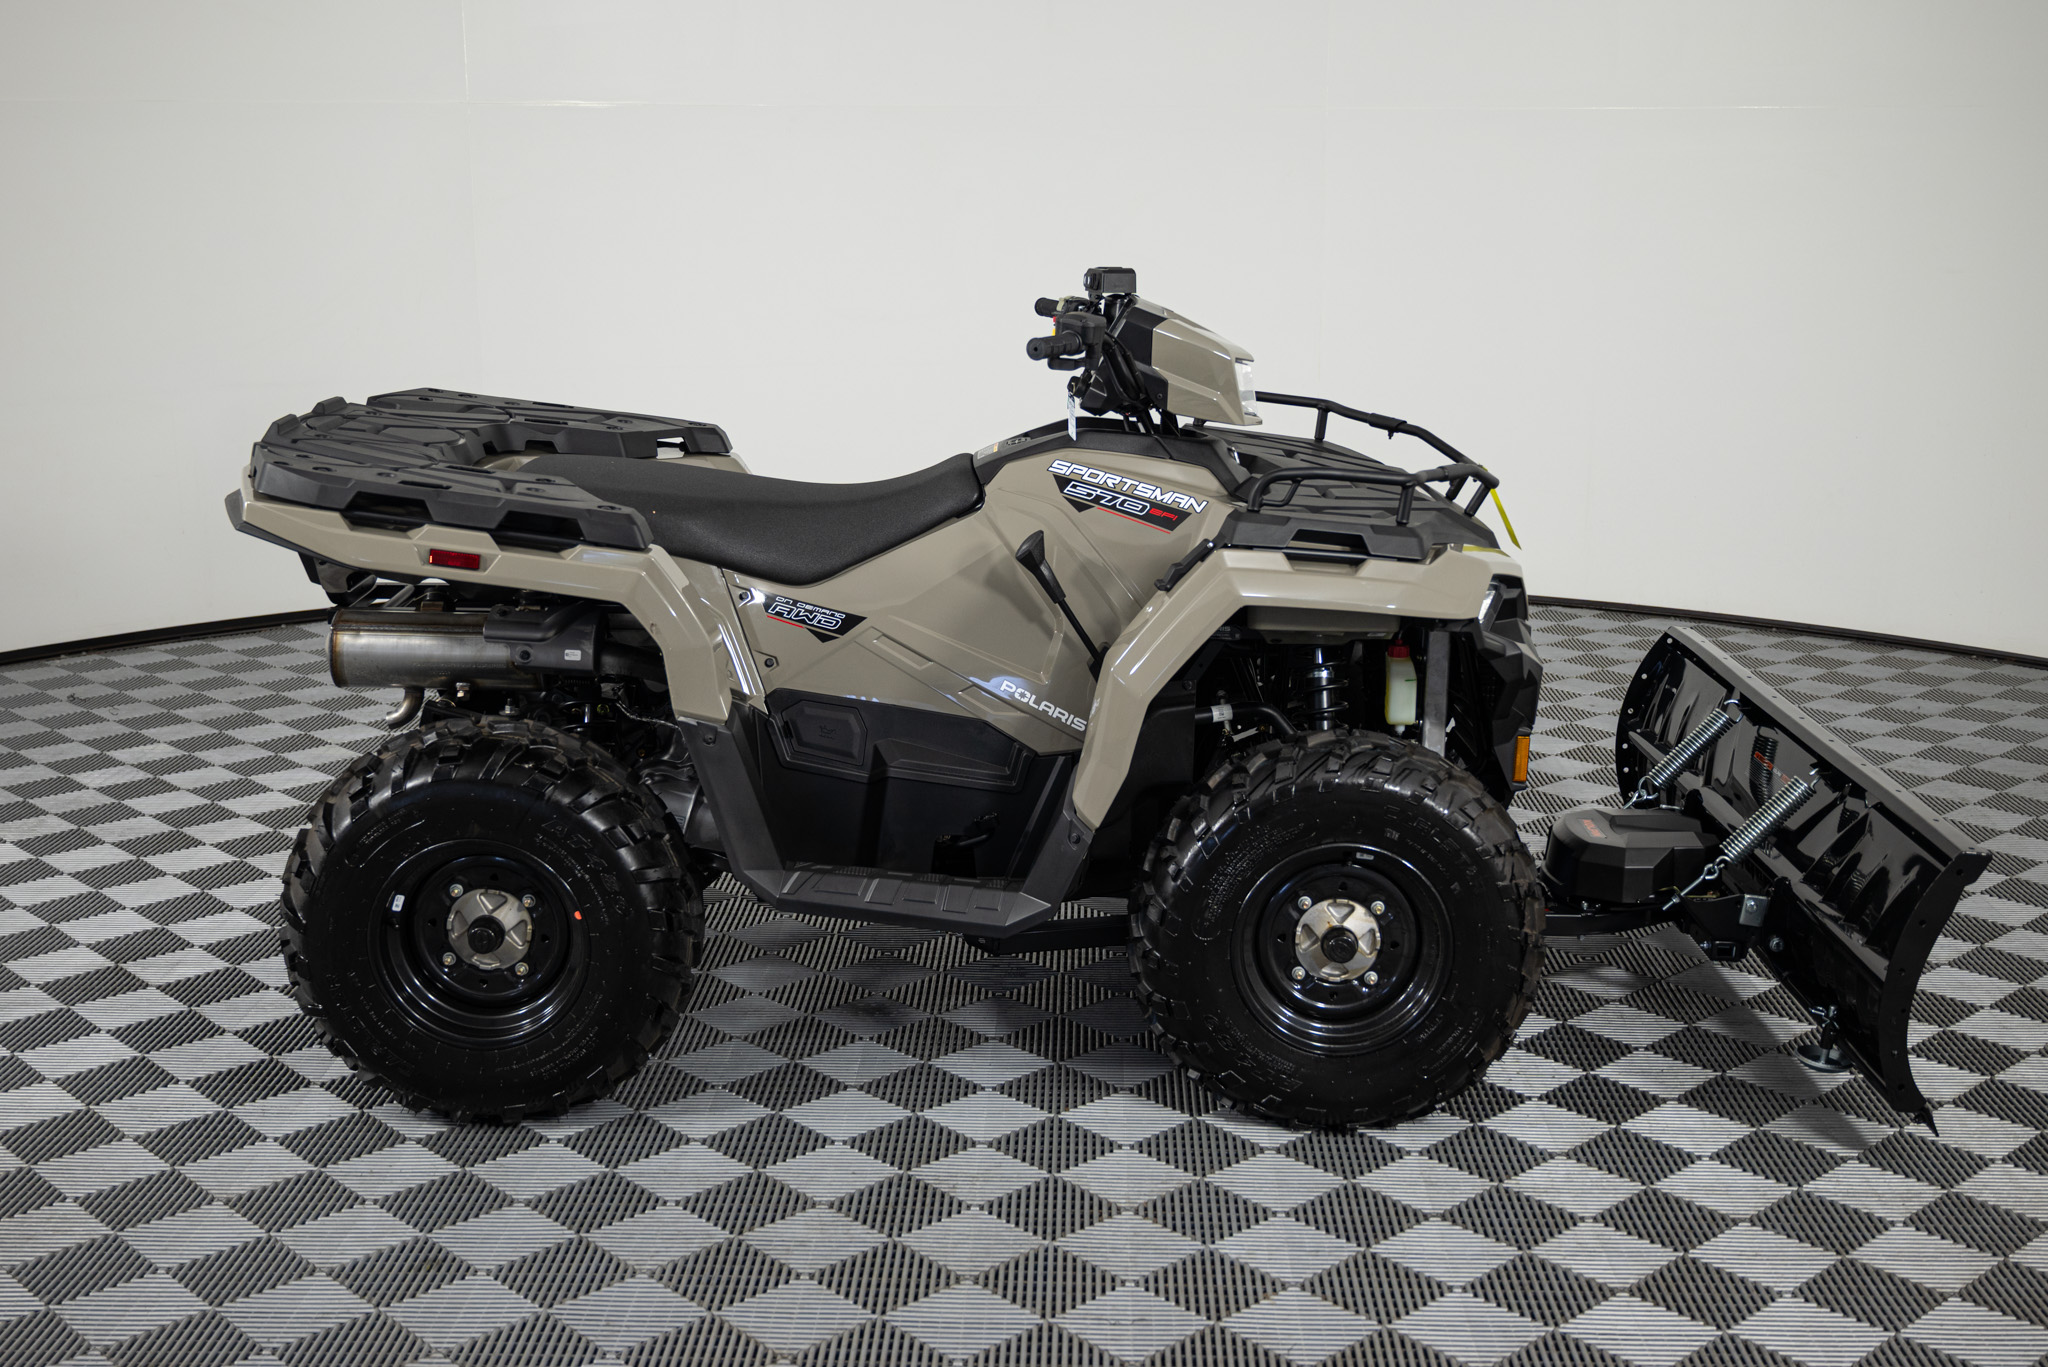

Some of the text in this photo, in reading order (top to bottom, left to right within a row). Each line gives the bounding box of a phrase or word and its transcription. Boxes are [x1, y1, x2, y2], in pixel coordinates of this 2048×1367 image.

[1047, 459, 1209, 514] SPORTSMAN
[1063, 481, 1151, 516] 570
[768, 602, 842, 630] AWD
[775, 596, 846, 619] ON DEMAND
[999, 680, 1088, 732] POLARIS
